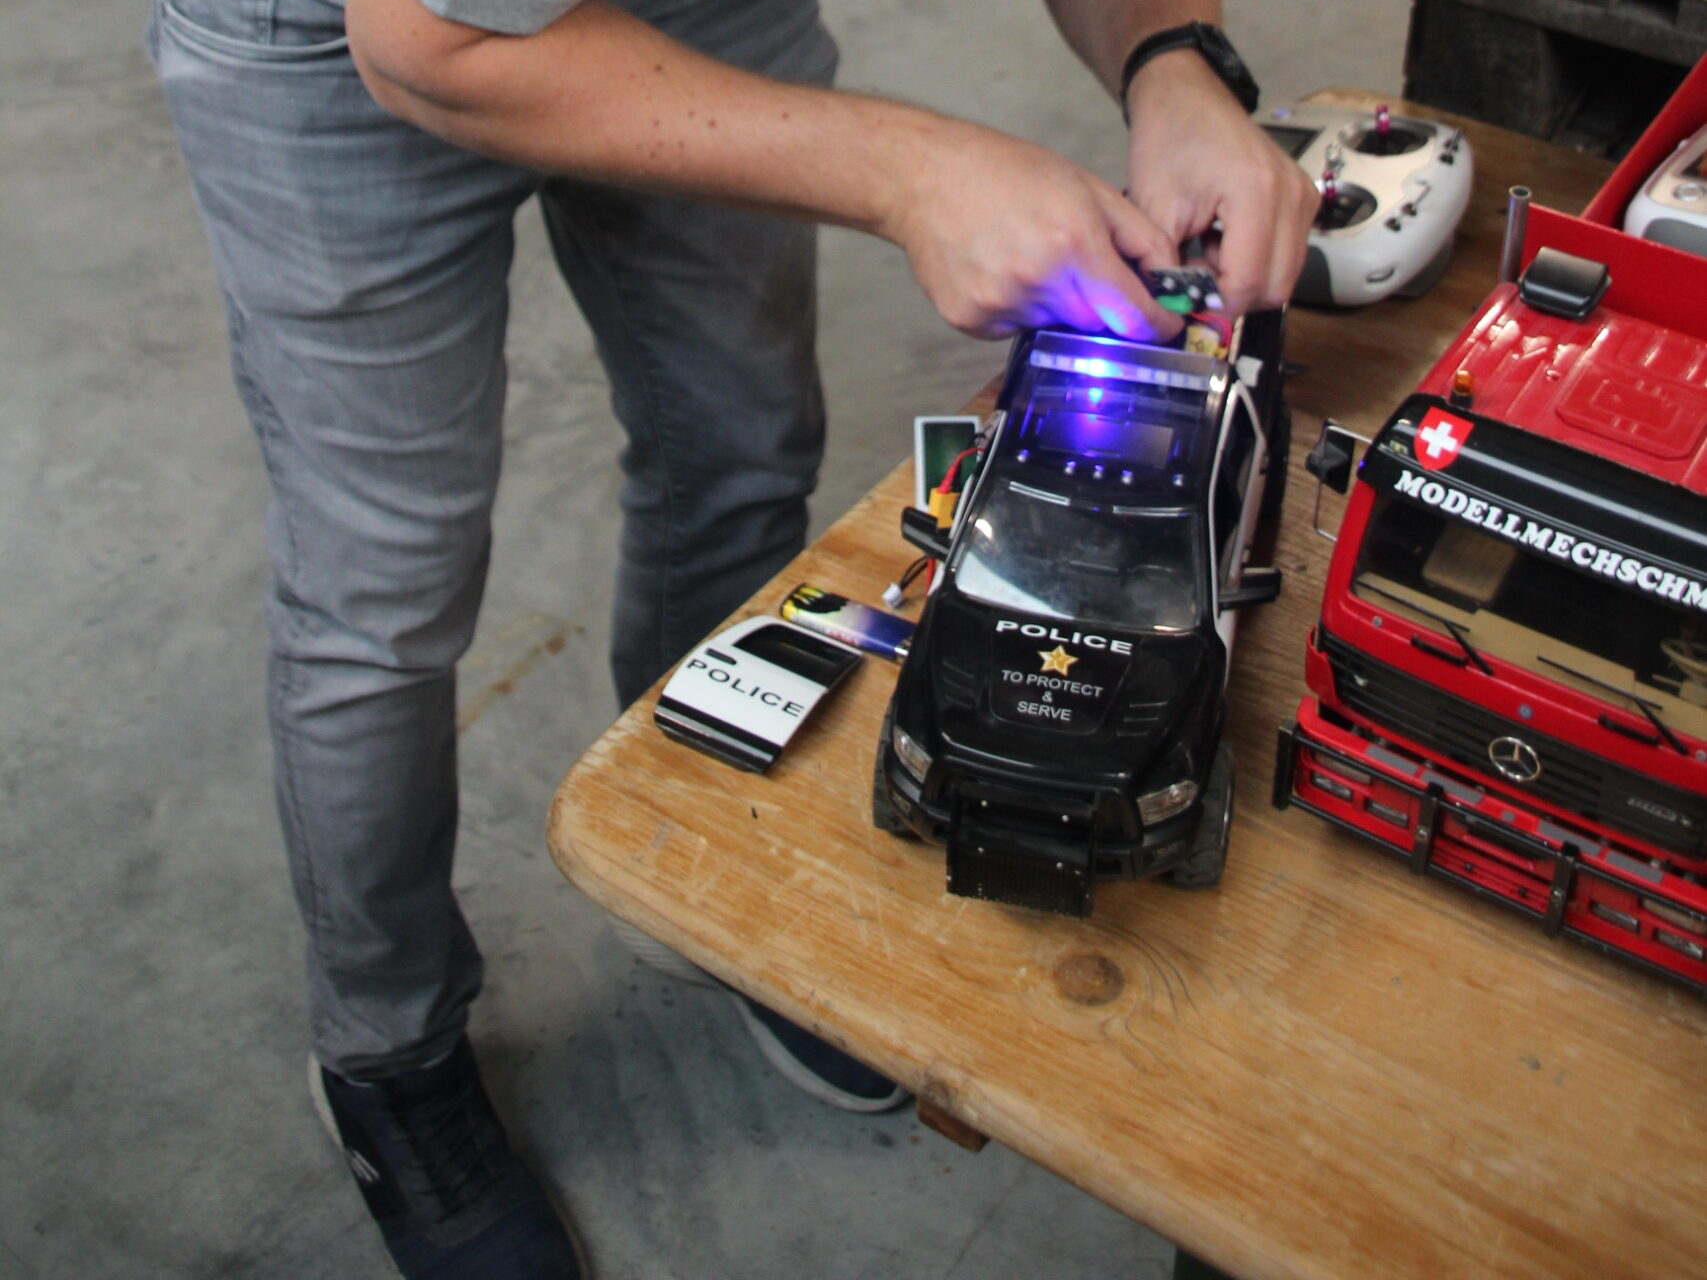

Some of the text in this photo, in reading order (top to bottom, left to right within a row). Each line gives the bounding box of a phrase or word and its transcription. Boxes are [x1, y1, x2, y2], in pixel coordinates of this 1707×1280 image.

[1394, 469, 1707, 611] MODELLMECHSCHM
[995, 619, 1133, 656] POLICE
[686, 657, 806, 718] POLICE
[1001, 669, 1104, 699] TO PROTECT
[1041, 690, 1053, 703] &
[1016, 700, 1073, 722] SERVE
